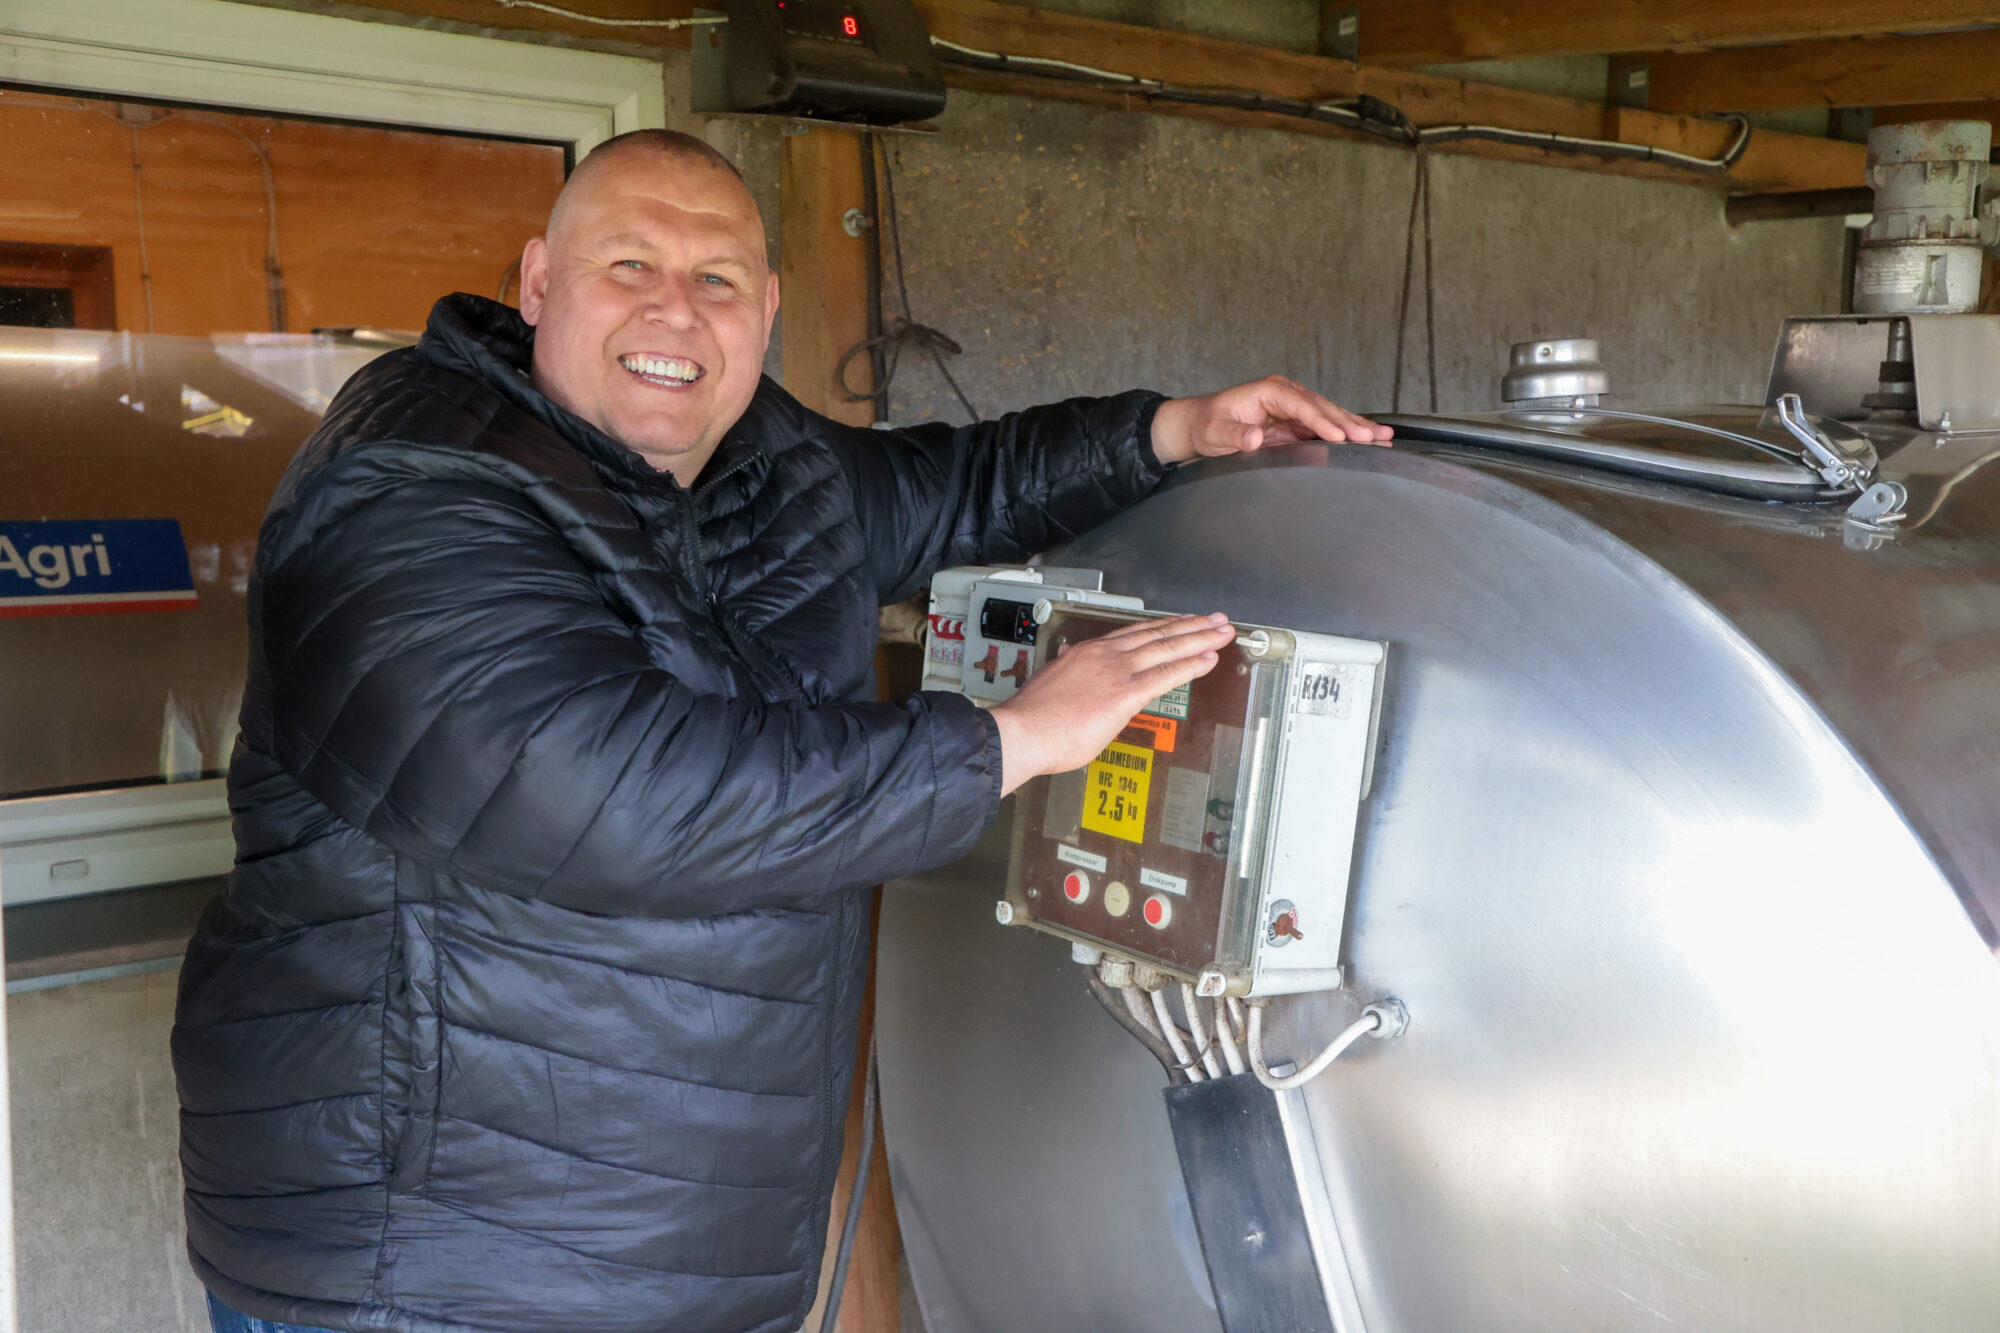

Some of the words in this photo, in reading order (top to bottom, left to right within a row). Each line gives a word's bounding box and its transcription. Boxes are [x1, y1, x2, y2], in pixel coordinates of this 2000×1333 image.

[843, 17, 857, 35] 8
[0, 534, 111, 589] Agri
[1302, 674, 1340, 703] R134
[1098, 770, 1113, 788] HFC
[1097, 790, 1124, 822] 2,5
[1127, 801, 1138, 820] kg
[1065, 851, 1098, 866] Kompressor
[1148, 874, 1177, 889] Diskpump
